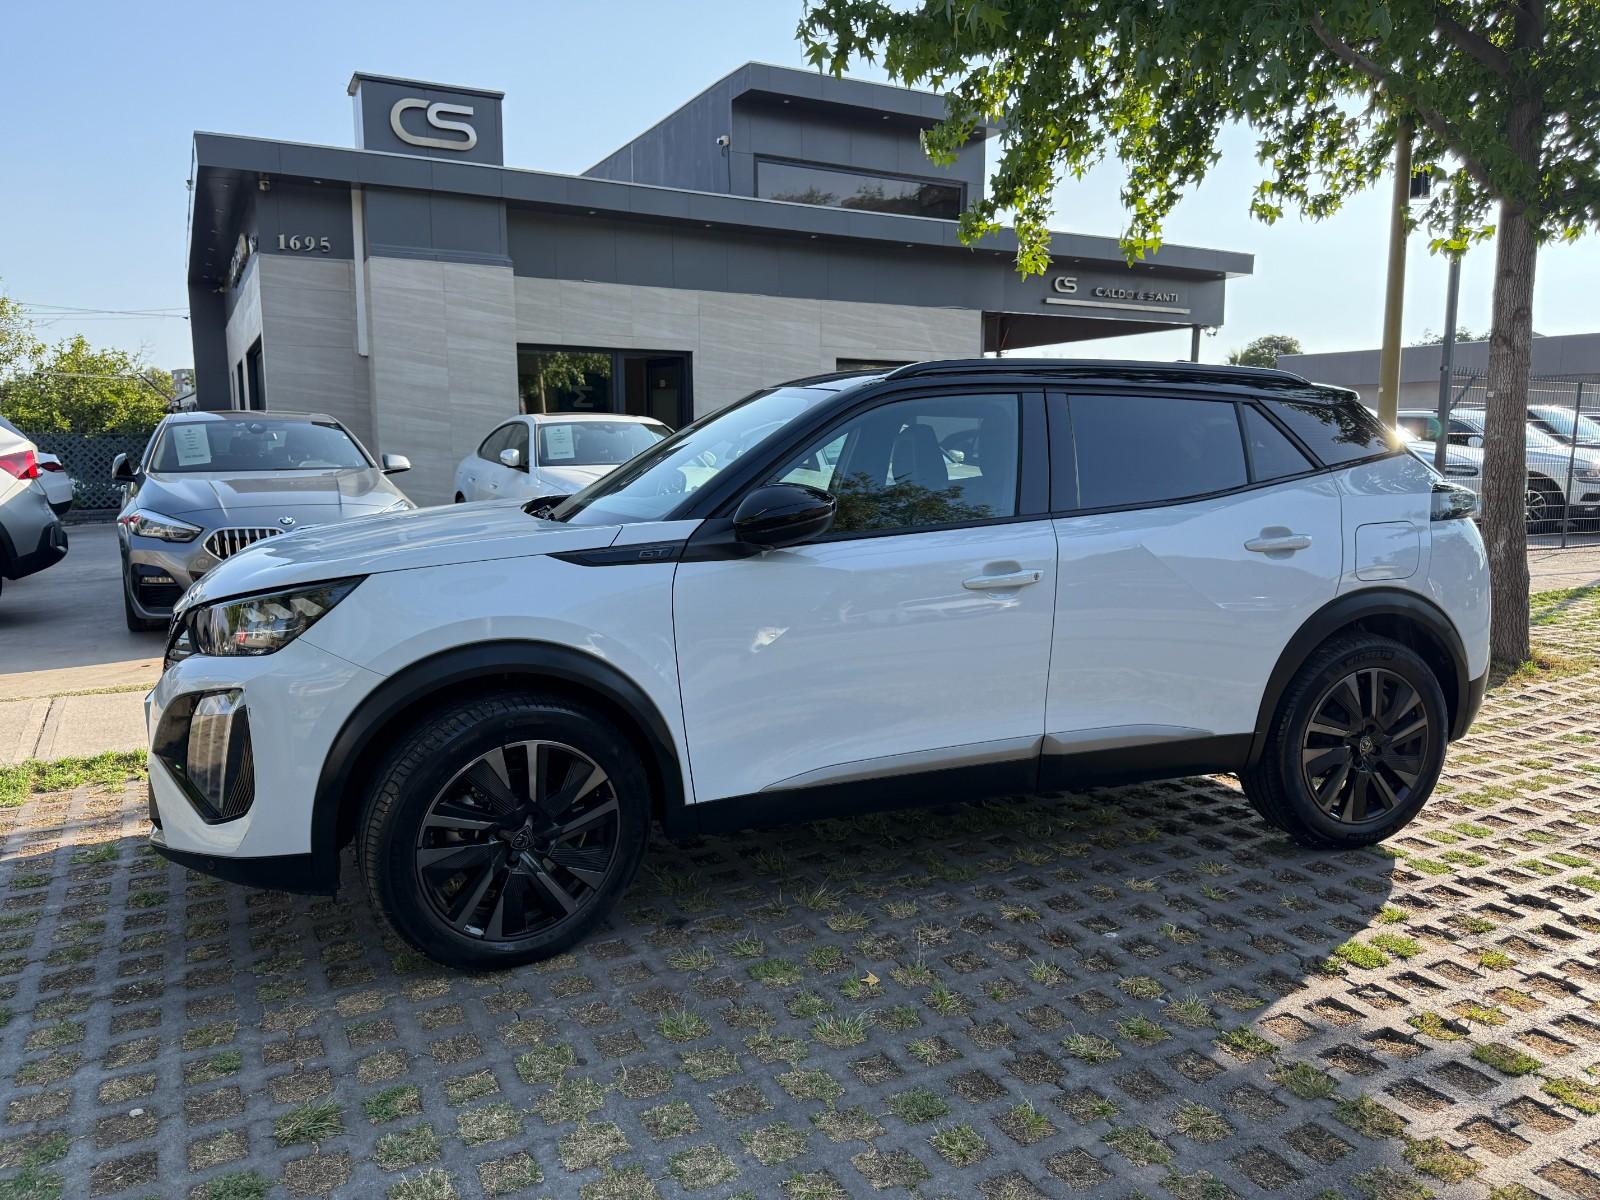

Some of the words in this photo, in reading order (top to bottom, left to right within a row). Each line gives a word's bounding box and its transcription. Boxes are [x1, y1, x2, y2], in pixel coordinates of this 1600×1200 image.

[390, 98, 477, 151] CS
[278, 233, 331, 253] 1695
[1055, 276, 1078, 293] CS
[1095, 287, 1134, 299] CALDO
[639, 549, 669, 558] GT
